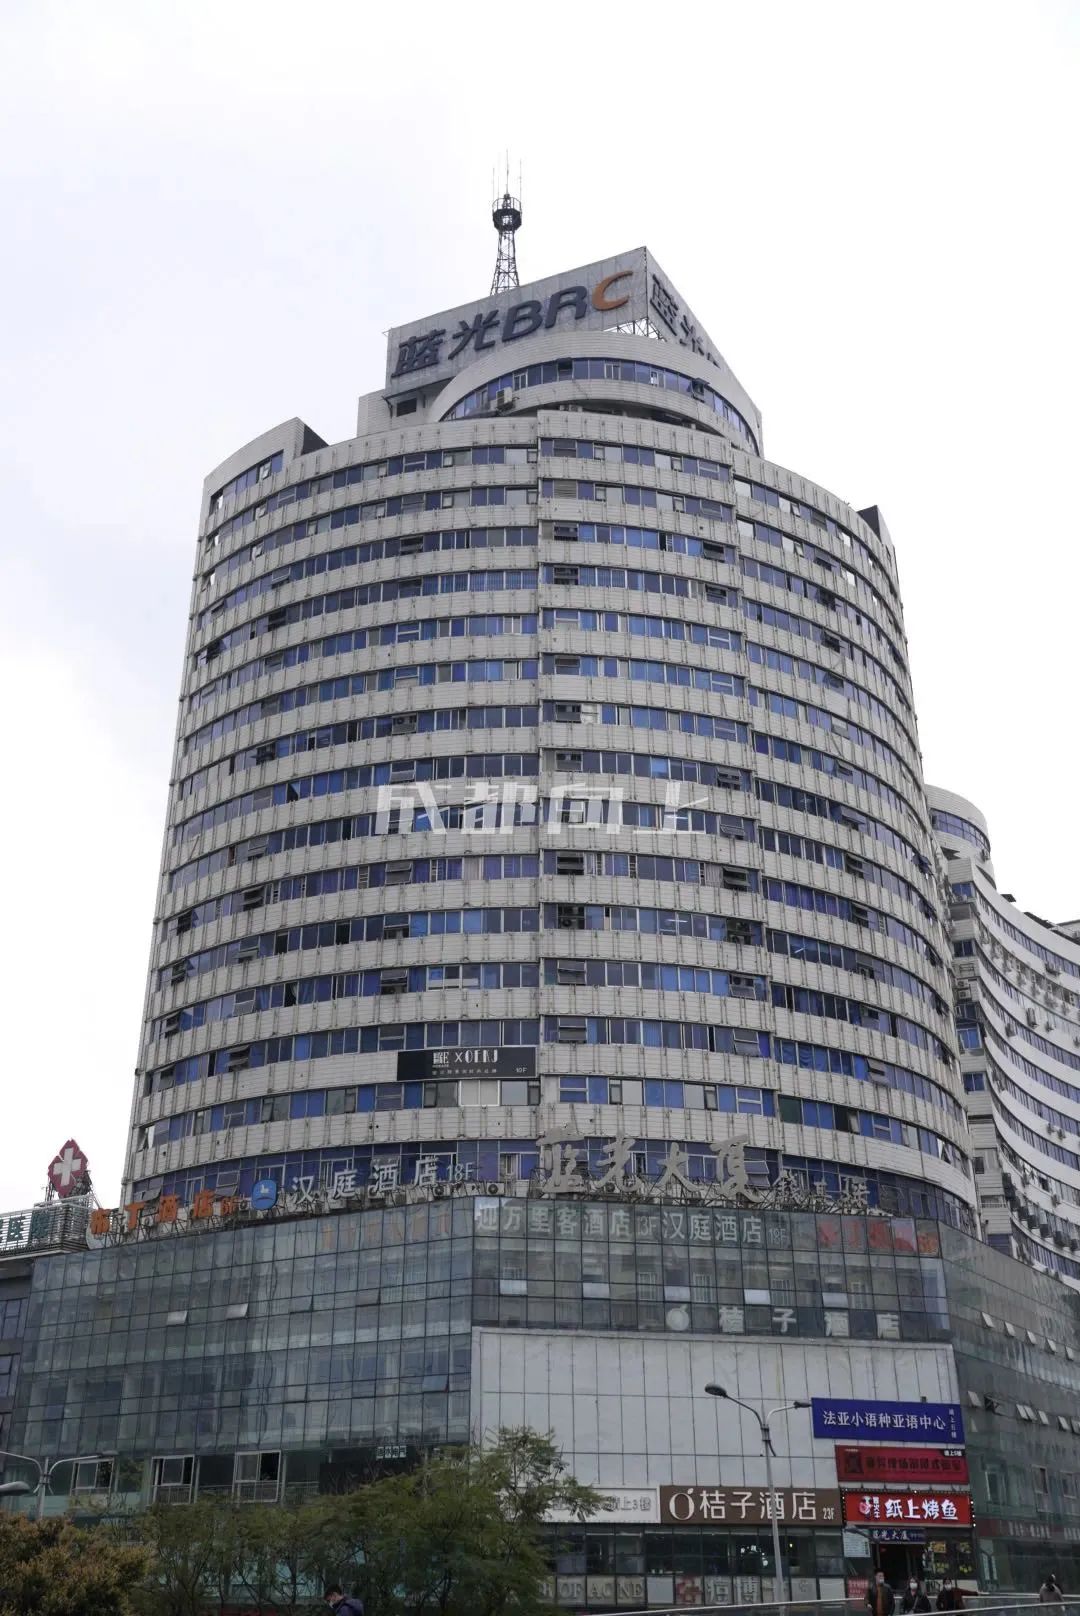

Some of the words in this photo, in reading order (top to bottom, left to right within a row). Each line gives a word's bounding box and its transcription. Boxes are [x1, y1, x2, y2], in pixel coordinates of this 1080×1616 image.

[292, 1155, 439, 1204] 汉庭酒店
[446, 1161, 475, 1183] 18F
[662, 1211, 762, 1244] 汉庭酒店
[823, 1411, 946, 1430] 法亚小语种亚语中心
[700, 1491, 817, 1520] 桔子酒店
[822, 1507, 834, 1520] 23F
[884, 1498, 959, 1520] 纸上烤鱼
